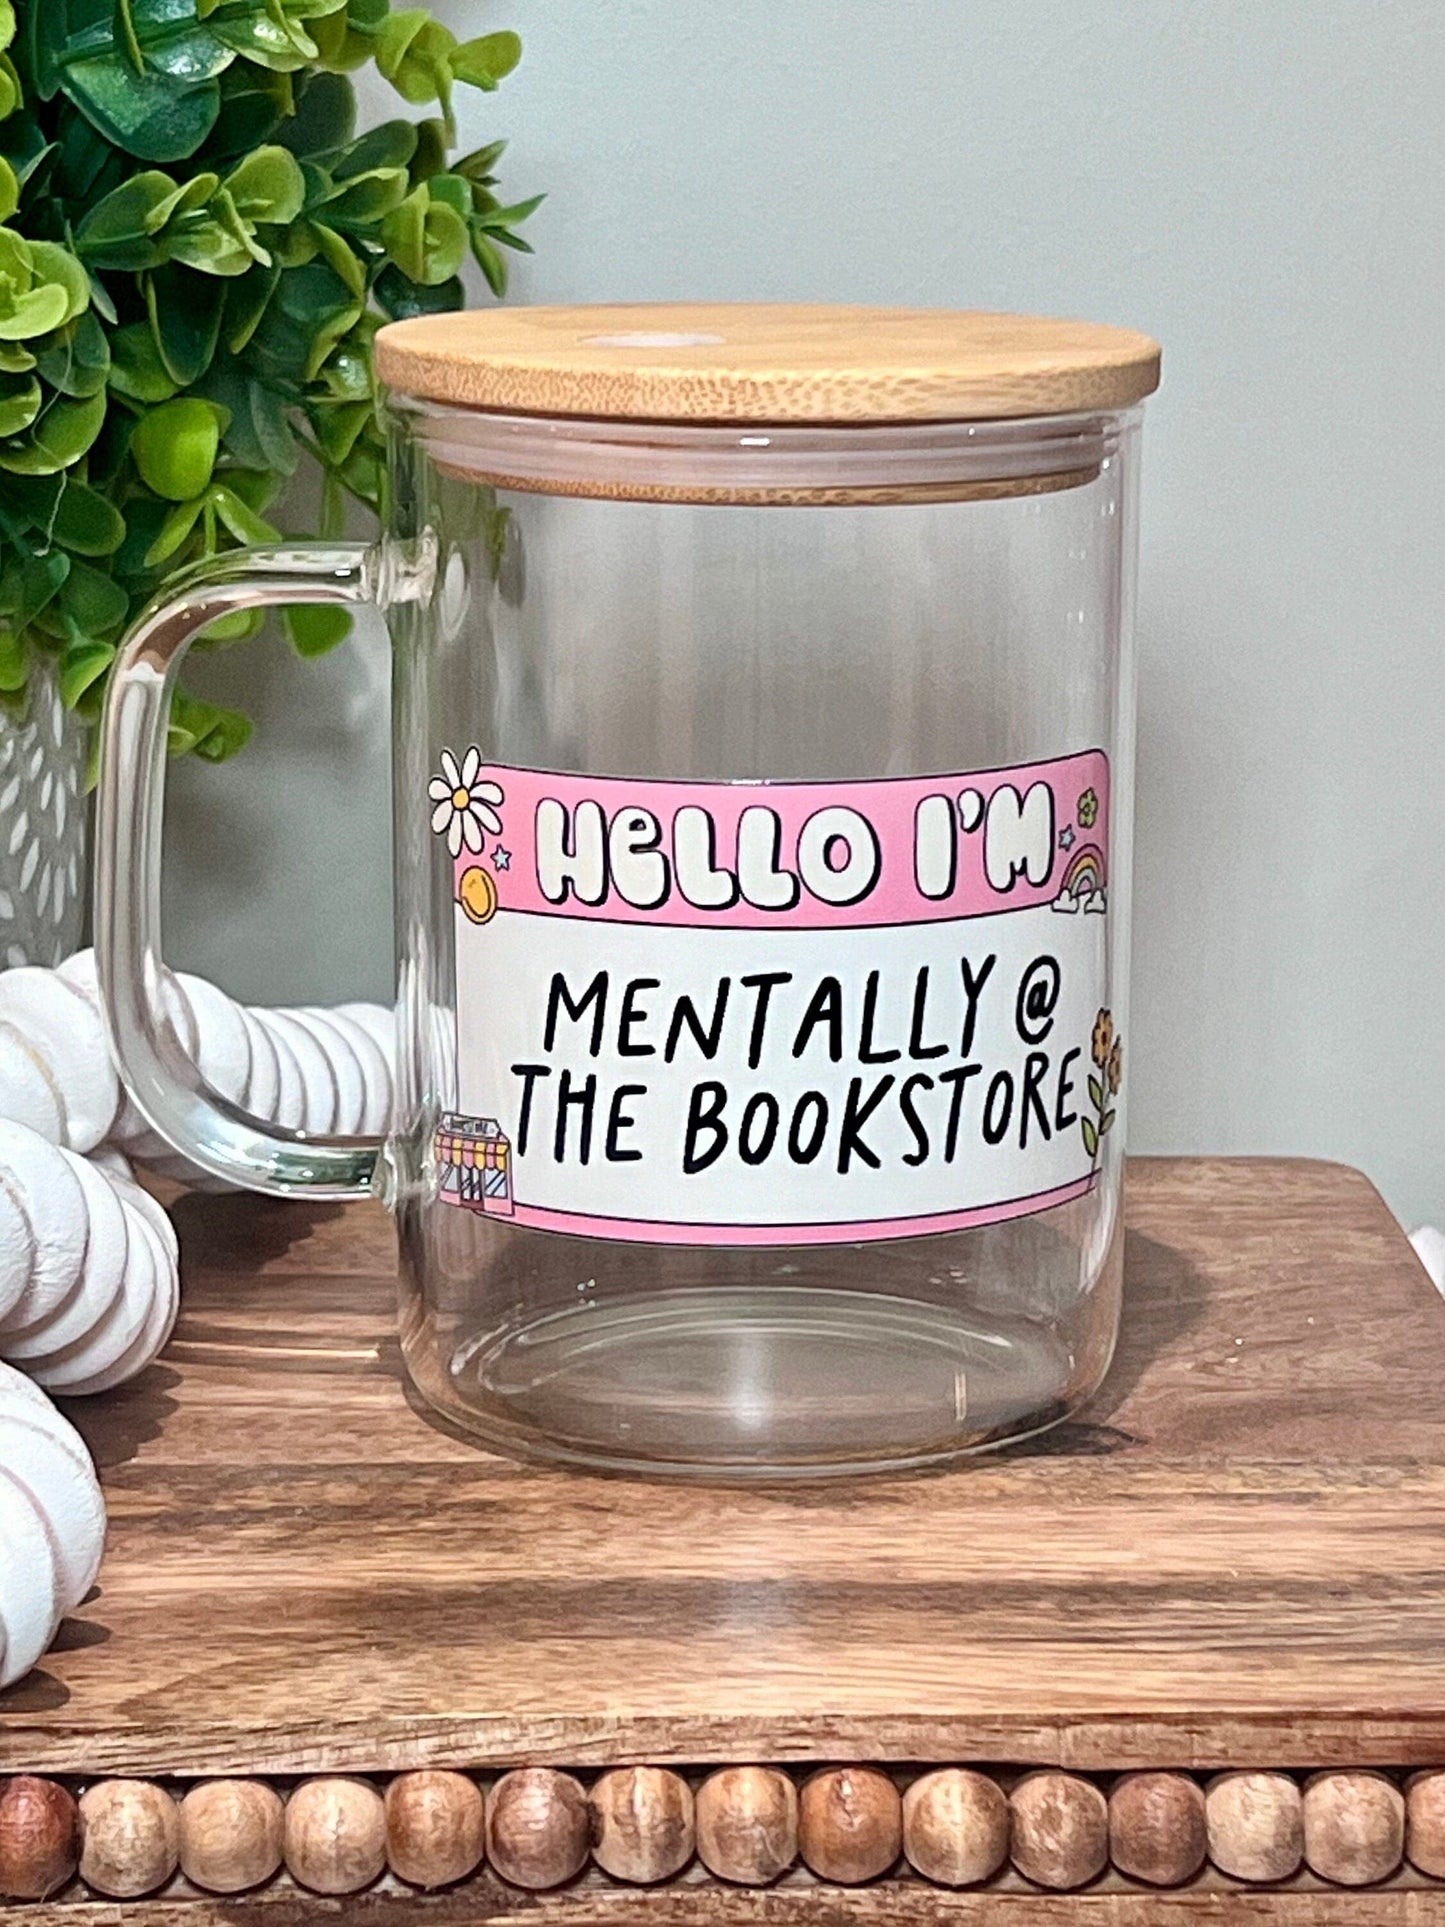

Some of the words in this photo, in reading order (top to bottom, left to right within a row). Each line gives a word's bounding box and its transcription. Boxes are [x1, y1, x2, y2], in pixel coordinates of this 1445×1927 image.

[914, 781, 1056, 902] I'M
[544, 955, 996, 1070] MENTALLY
[1016, 956, 1061, 1046] @
[511, 1064, 648, 1166] THE
[683, 1047, 1082, 1175] BOOKSTORE
